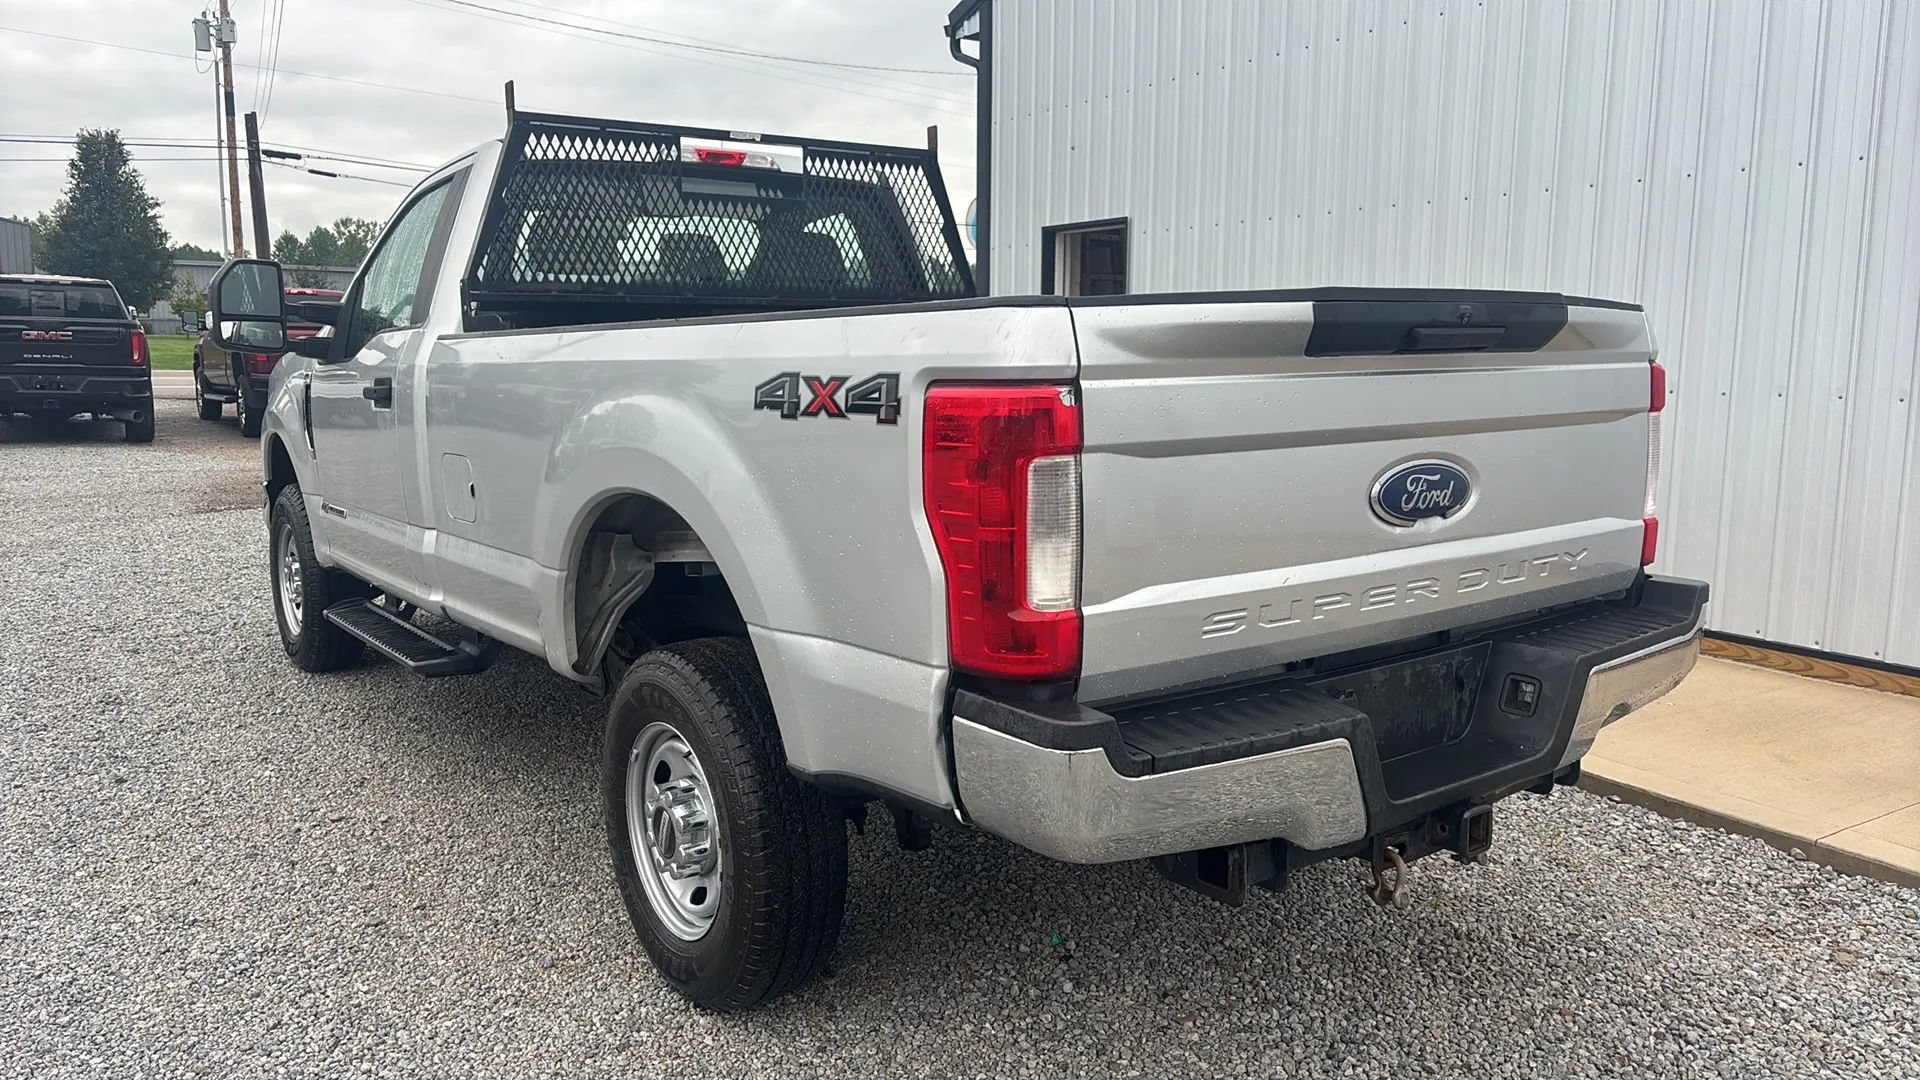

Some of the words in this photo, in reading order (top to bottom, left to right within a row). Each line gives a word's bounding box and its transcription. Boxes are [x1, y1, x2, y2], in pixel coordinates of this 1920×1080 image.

[22, 330, 72, 340] GMC
[1401, 473, 1453, 512] Ford
[1201, 576, 1442, 639] SUPER
[1457, 547, 1589, 594] DUTY
